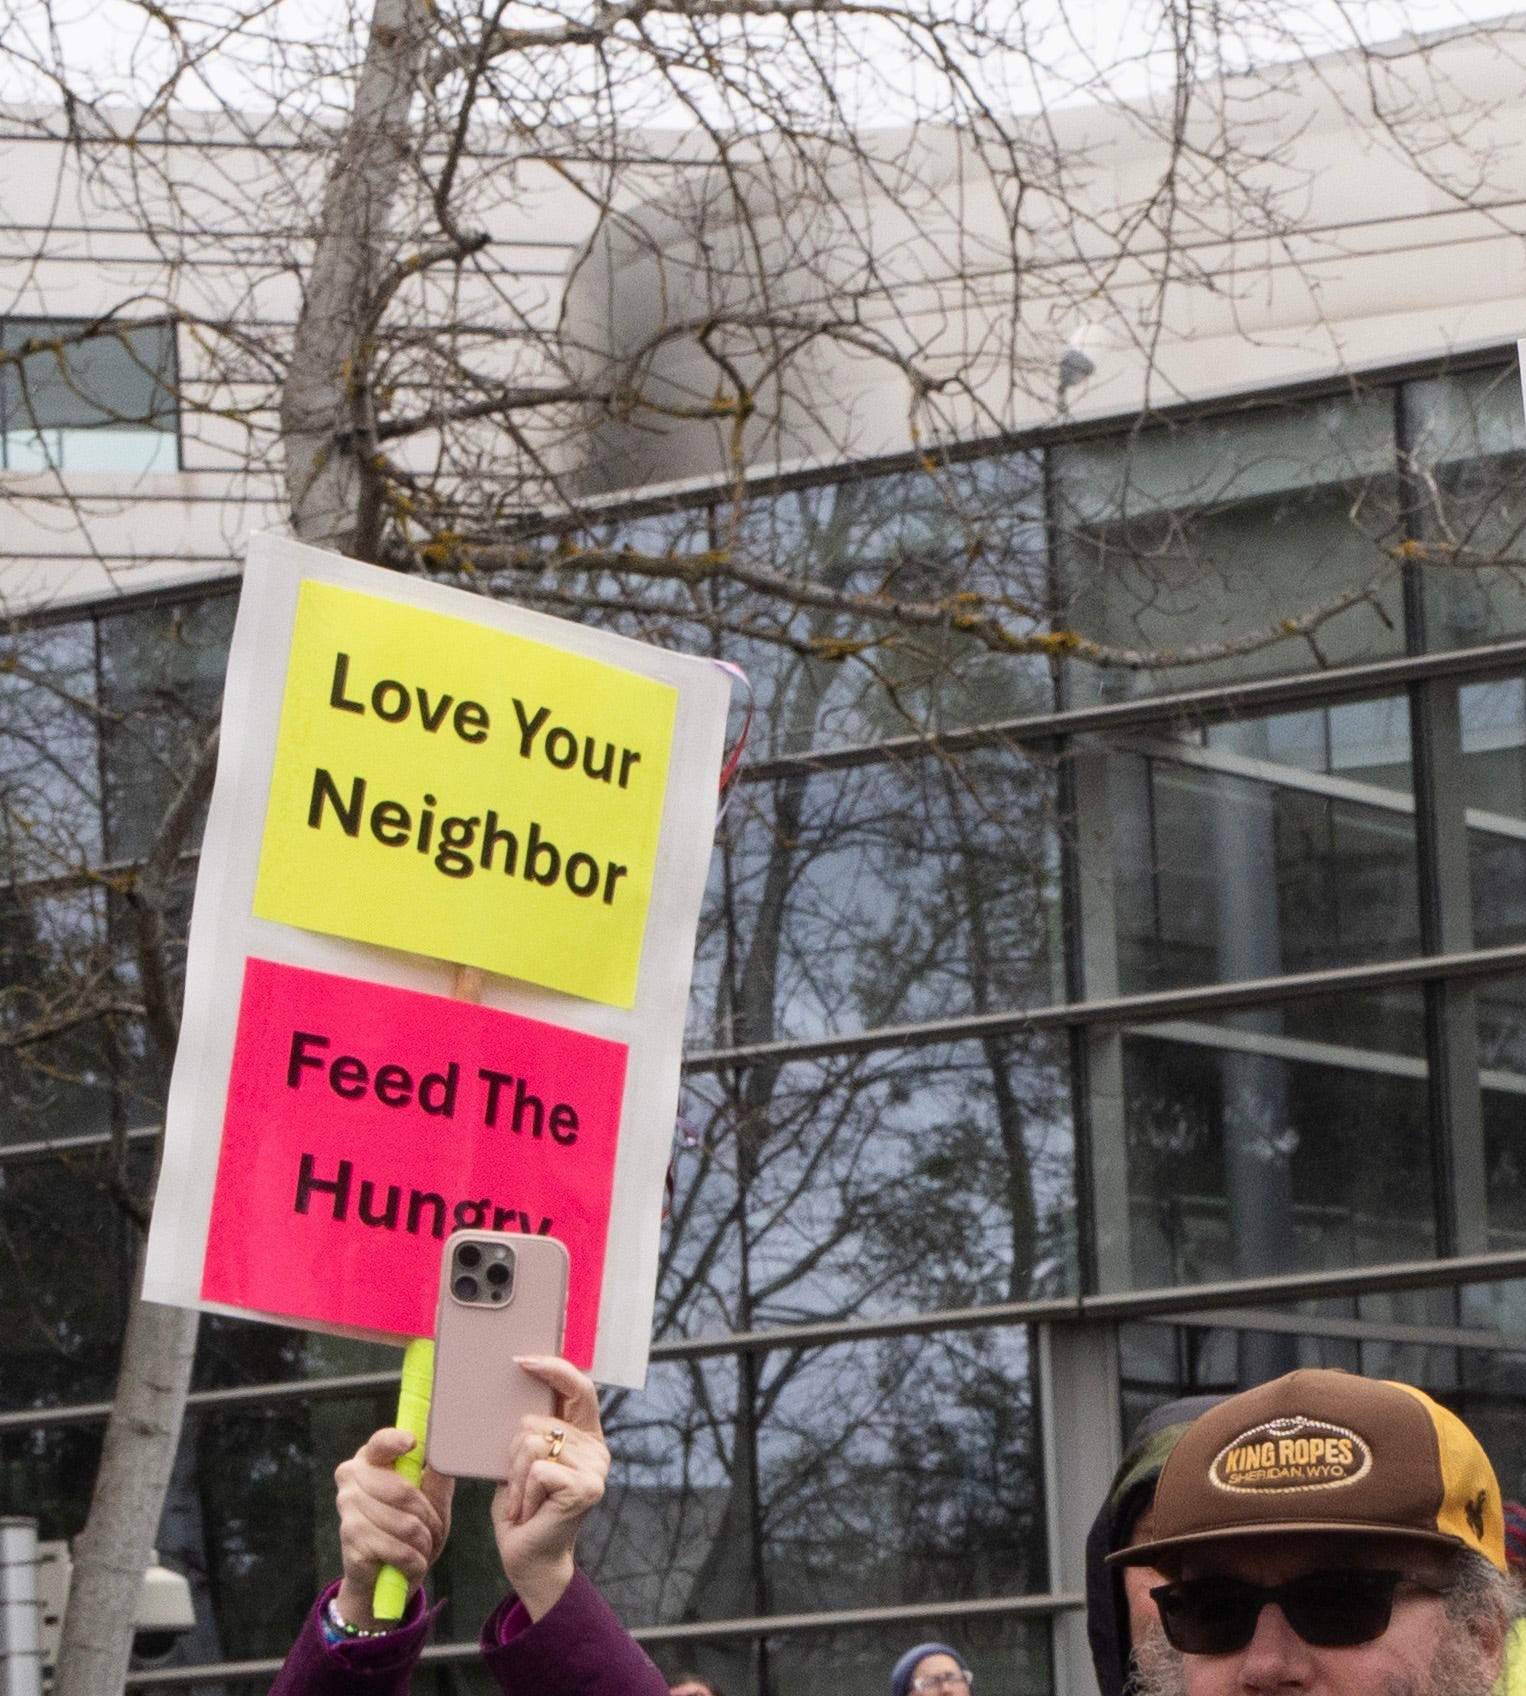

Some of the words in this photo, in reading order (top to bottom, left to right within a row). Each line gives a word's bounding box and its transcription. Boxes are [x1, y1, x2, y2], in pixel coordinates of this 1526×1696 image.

[329, 652, 489, 745] Love
[511, 697, 642, 790] Your
[306, 767, 628, 906] Neighbor
[286, 1030, 461, 1119] Feed
[477, 1067, 581, 1147] The
[1225, 1441, 1276, 1473] KING
[1279, 1438, 1354, 1465] ROPES
[1306, 1465, 1347, 1478] WYO.
